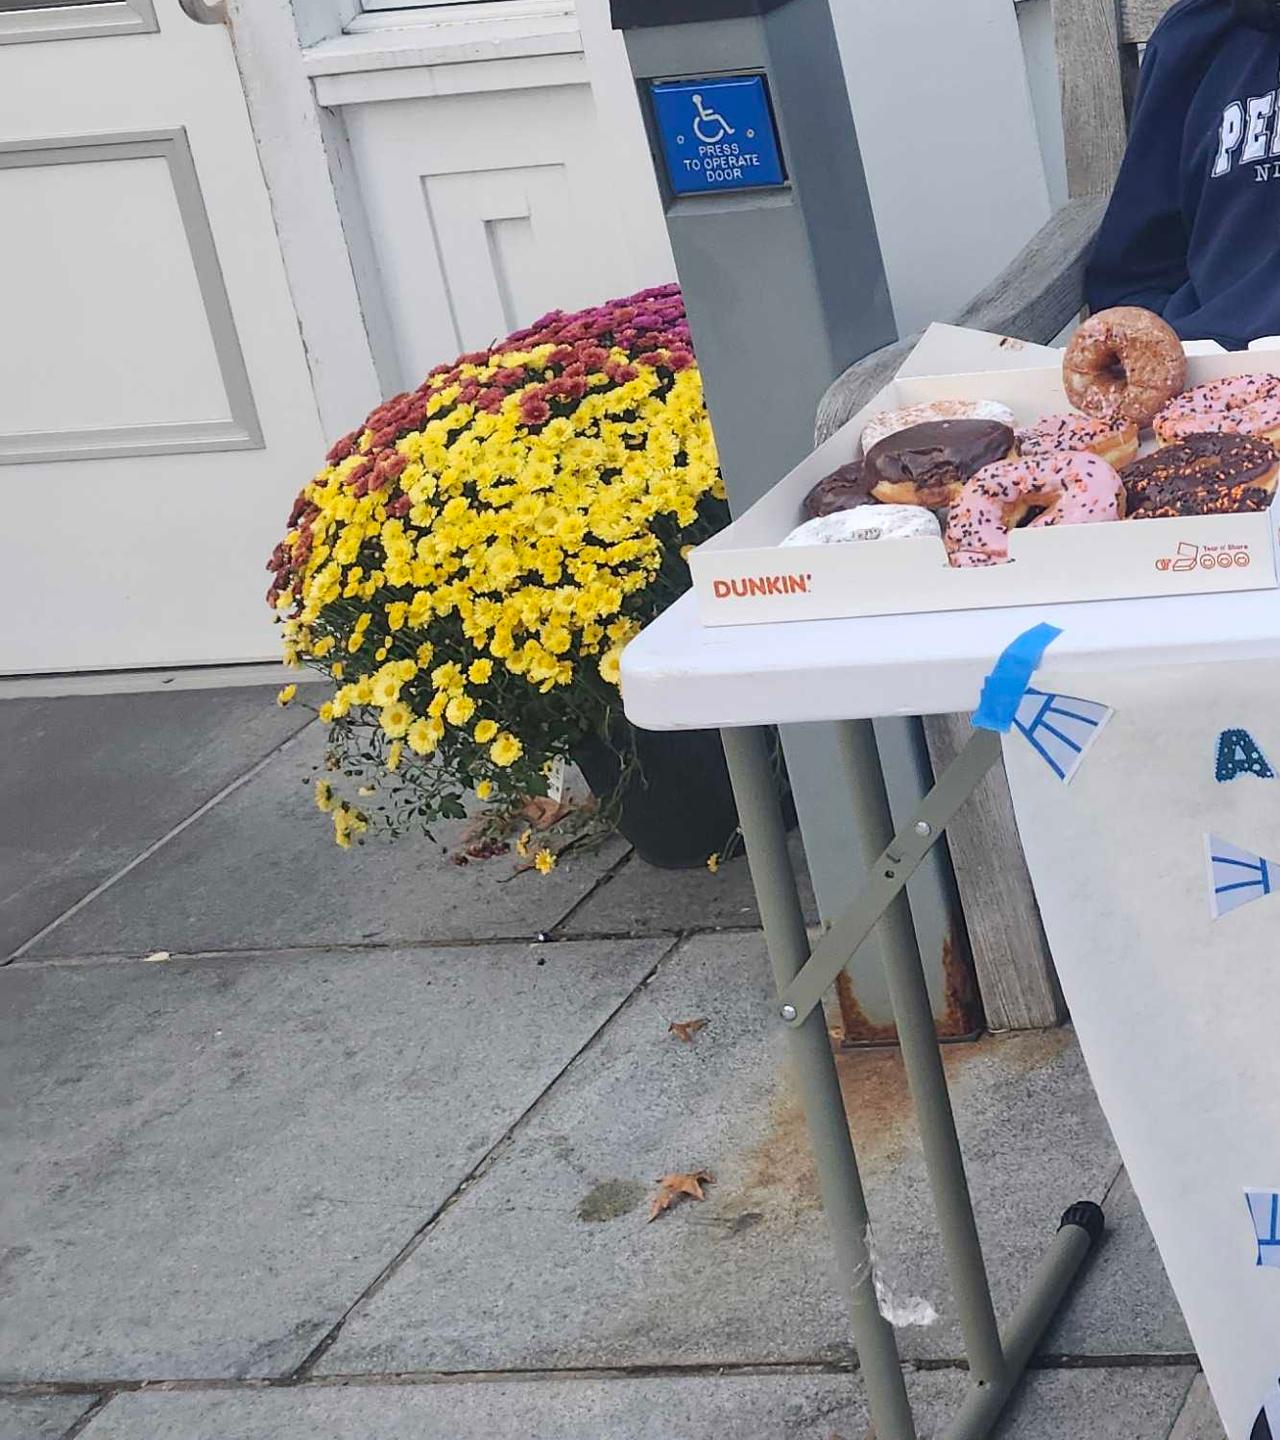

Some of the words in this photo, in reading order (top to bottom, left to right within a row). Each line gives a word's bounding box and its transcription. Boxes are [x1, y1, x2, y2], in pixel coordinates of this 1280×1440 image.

[698, 143, 739, 157] PRESS
[684, 160, 700, 171] TO
[704, 154, 760, 170] OPERATE
[706, 168, 743, 182] DOOR
[714, 573, 812, 599] DUNKIN'
